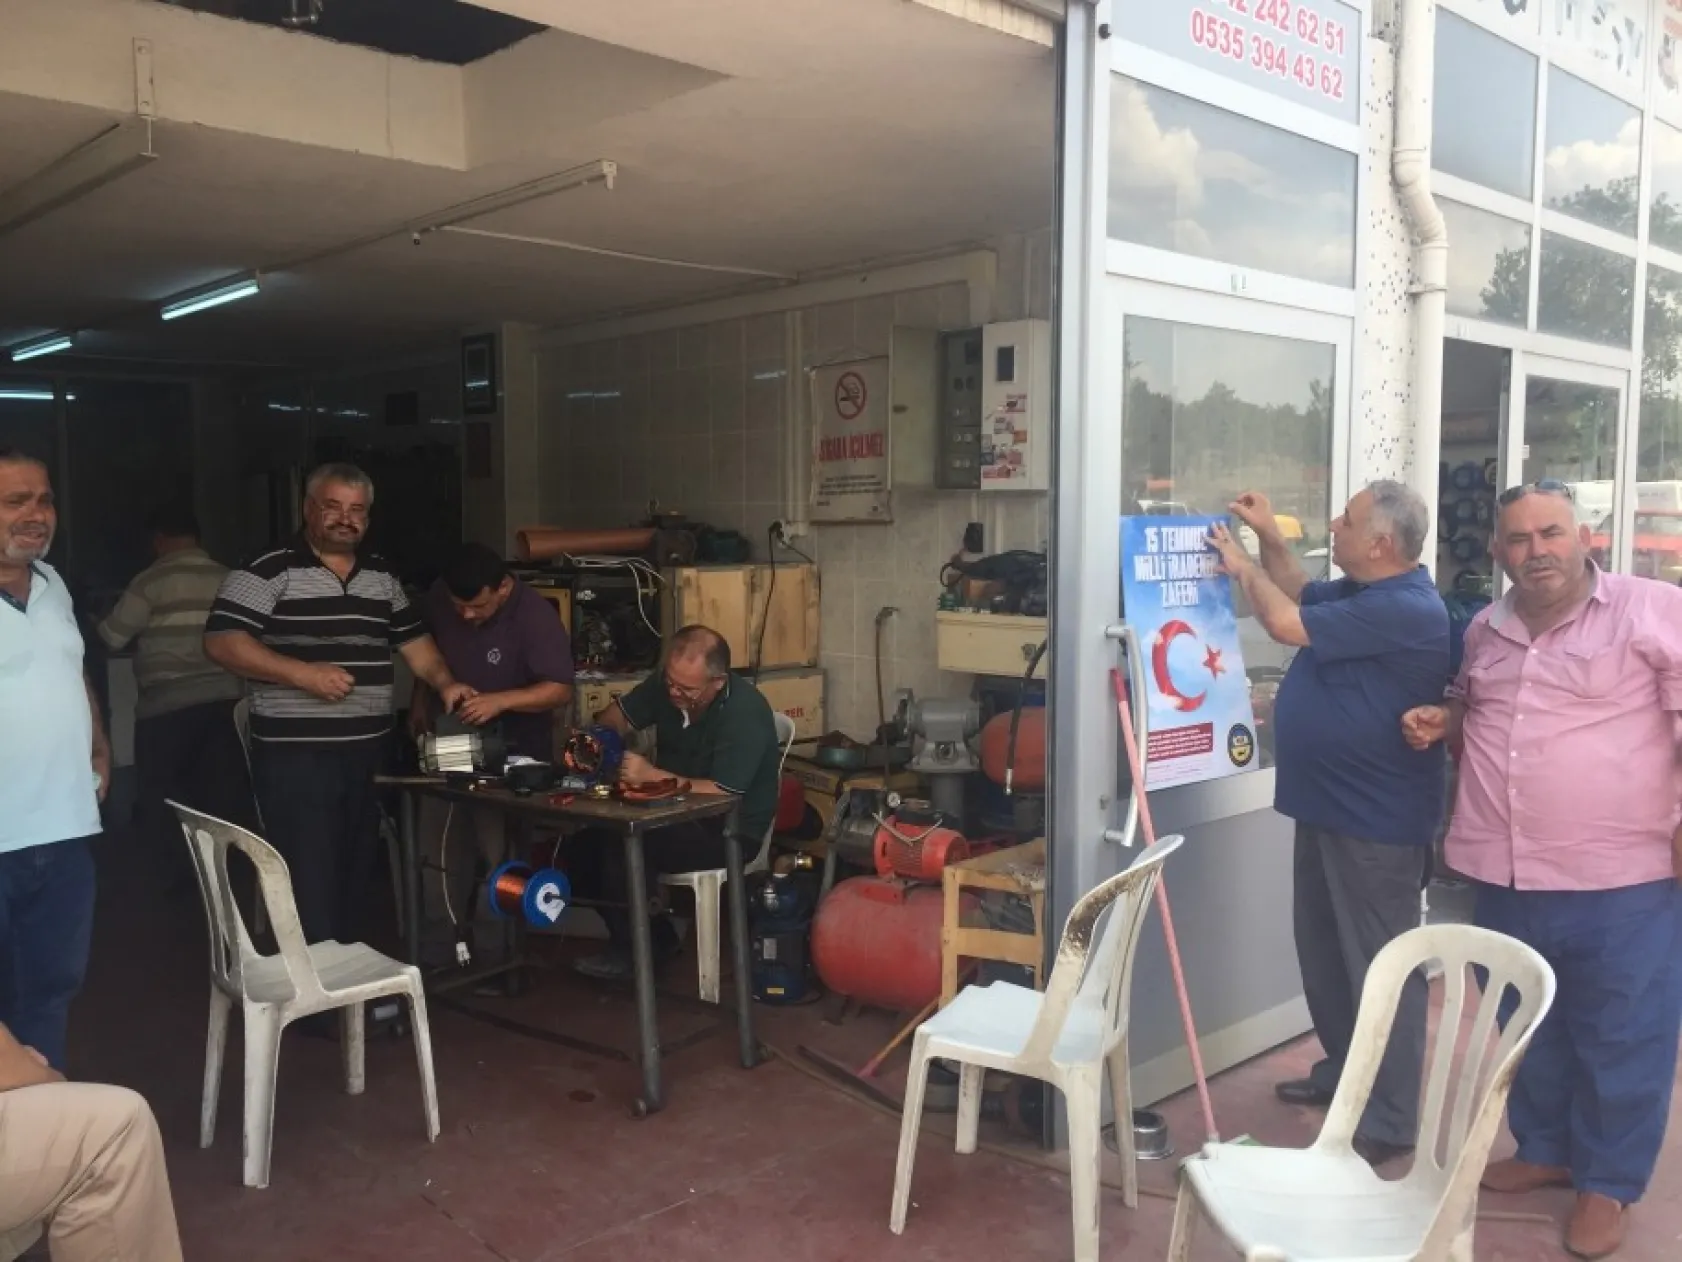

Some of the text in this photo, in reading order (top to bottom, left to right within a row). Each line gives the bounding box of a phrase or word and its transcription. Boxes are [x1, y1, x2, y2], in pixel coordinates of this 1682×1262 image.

[1191, 9, 1343, 99] 0535 394 43 62
[1254, 0, 1345, 56] 242 62 51
[1144, 527, 1158, 553] 15
